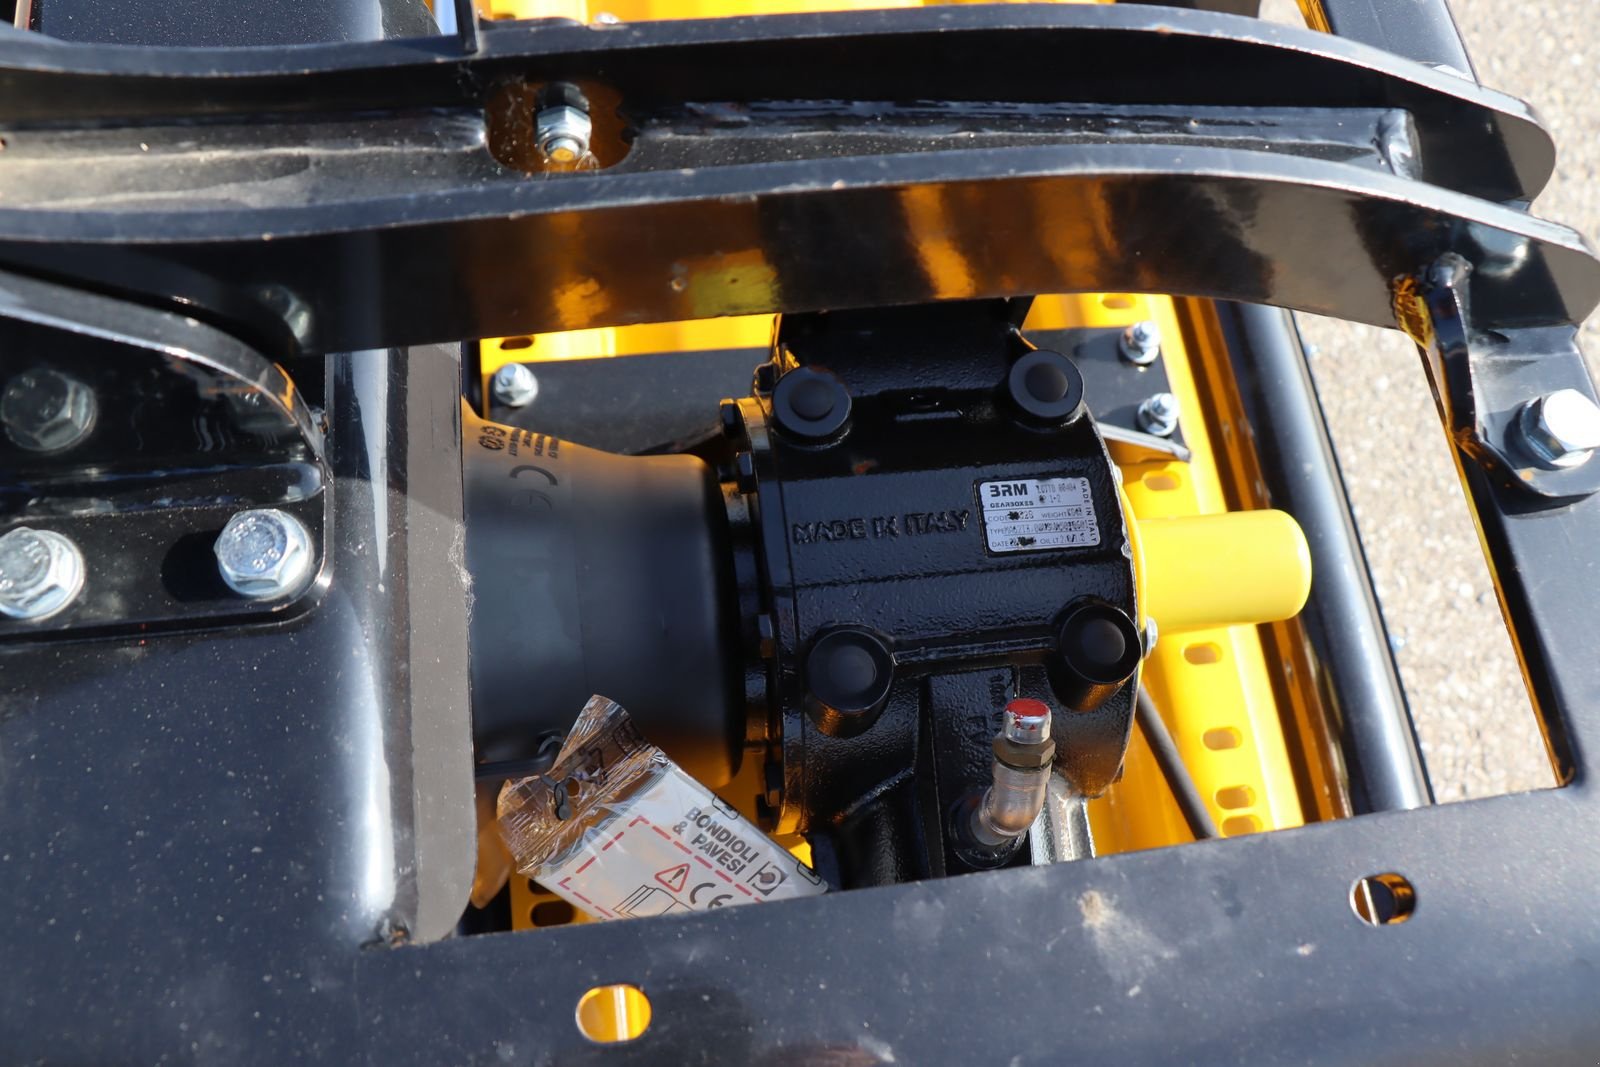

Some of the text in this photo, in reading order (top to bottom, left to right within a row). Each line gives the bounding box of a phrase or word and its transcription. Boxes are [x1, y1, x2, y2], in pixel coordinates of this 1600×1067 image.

[989, 483, 1028, 498] BRM
[989, 500, 1034, 508] GEARBOXES
[1080, 480, 1097, 542] MADE IN ITALY
[988, 513, 1008, 521] CODE
[792, 509, 970, 545] MADE IN ITALY
[992, 539, 1011, 547] DATE
[1052, 536, 1059, 544] LT
[684, 806, 760, 864] BONDIOLI
[672, 820, 747, 876] & PAVESI
